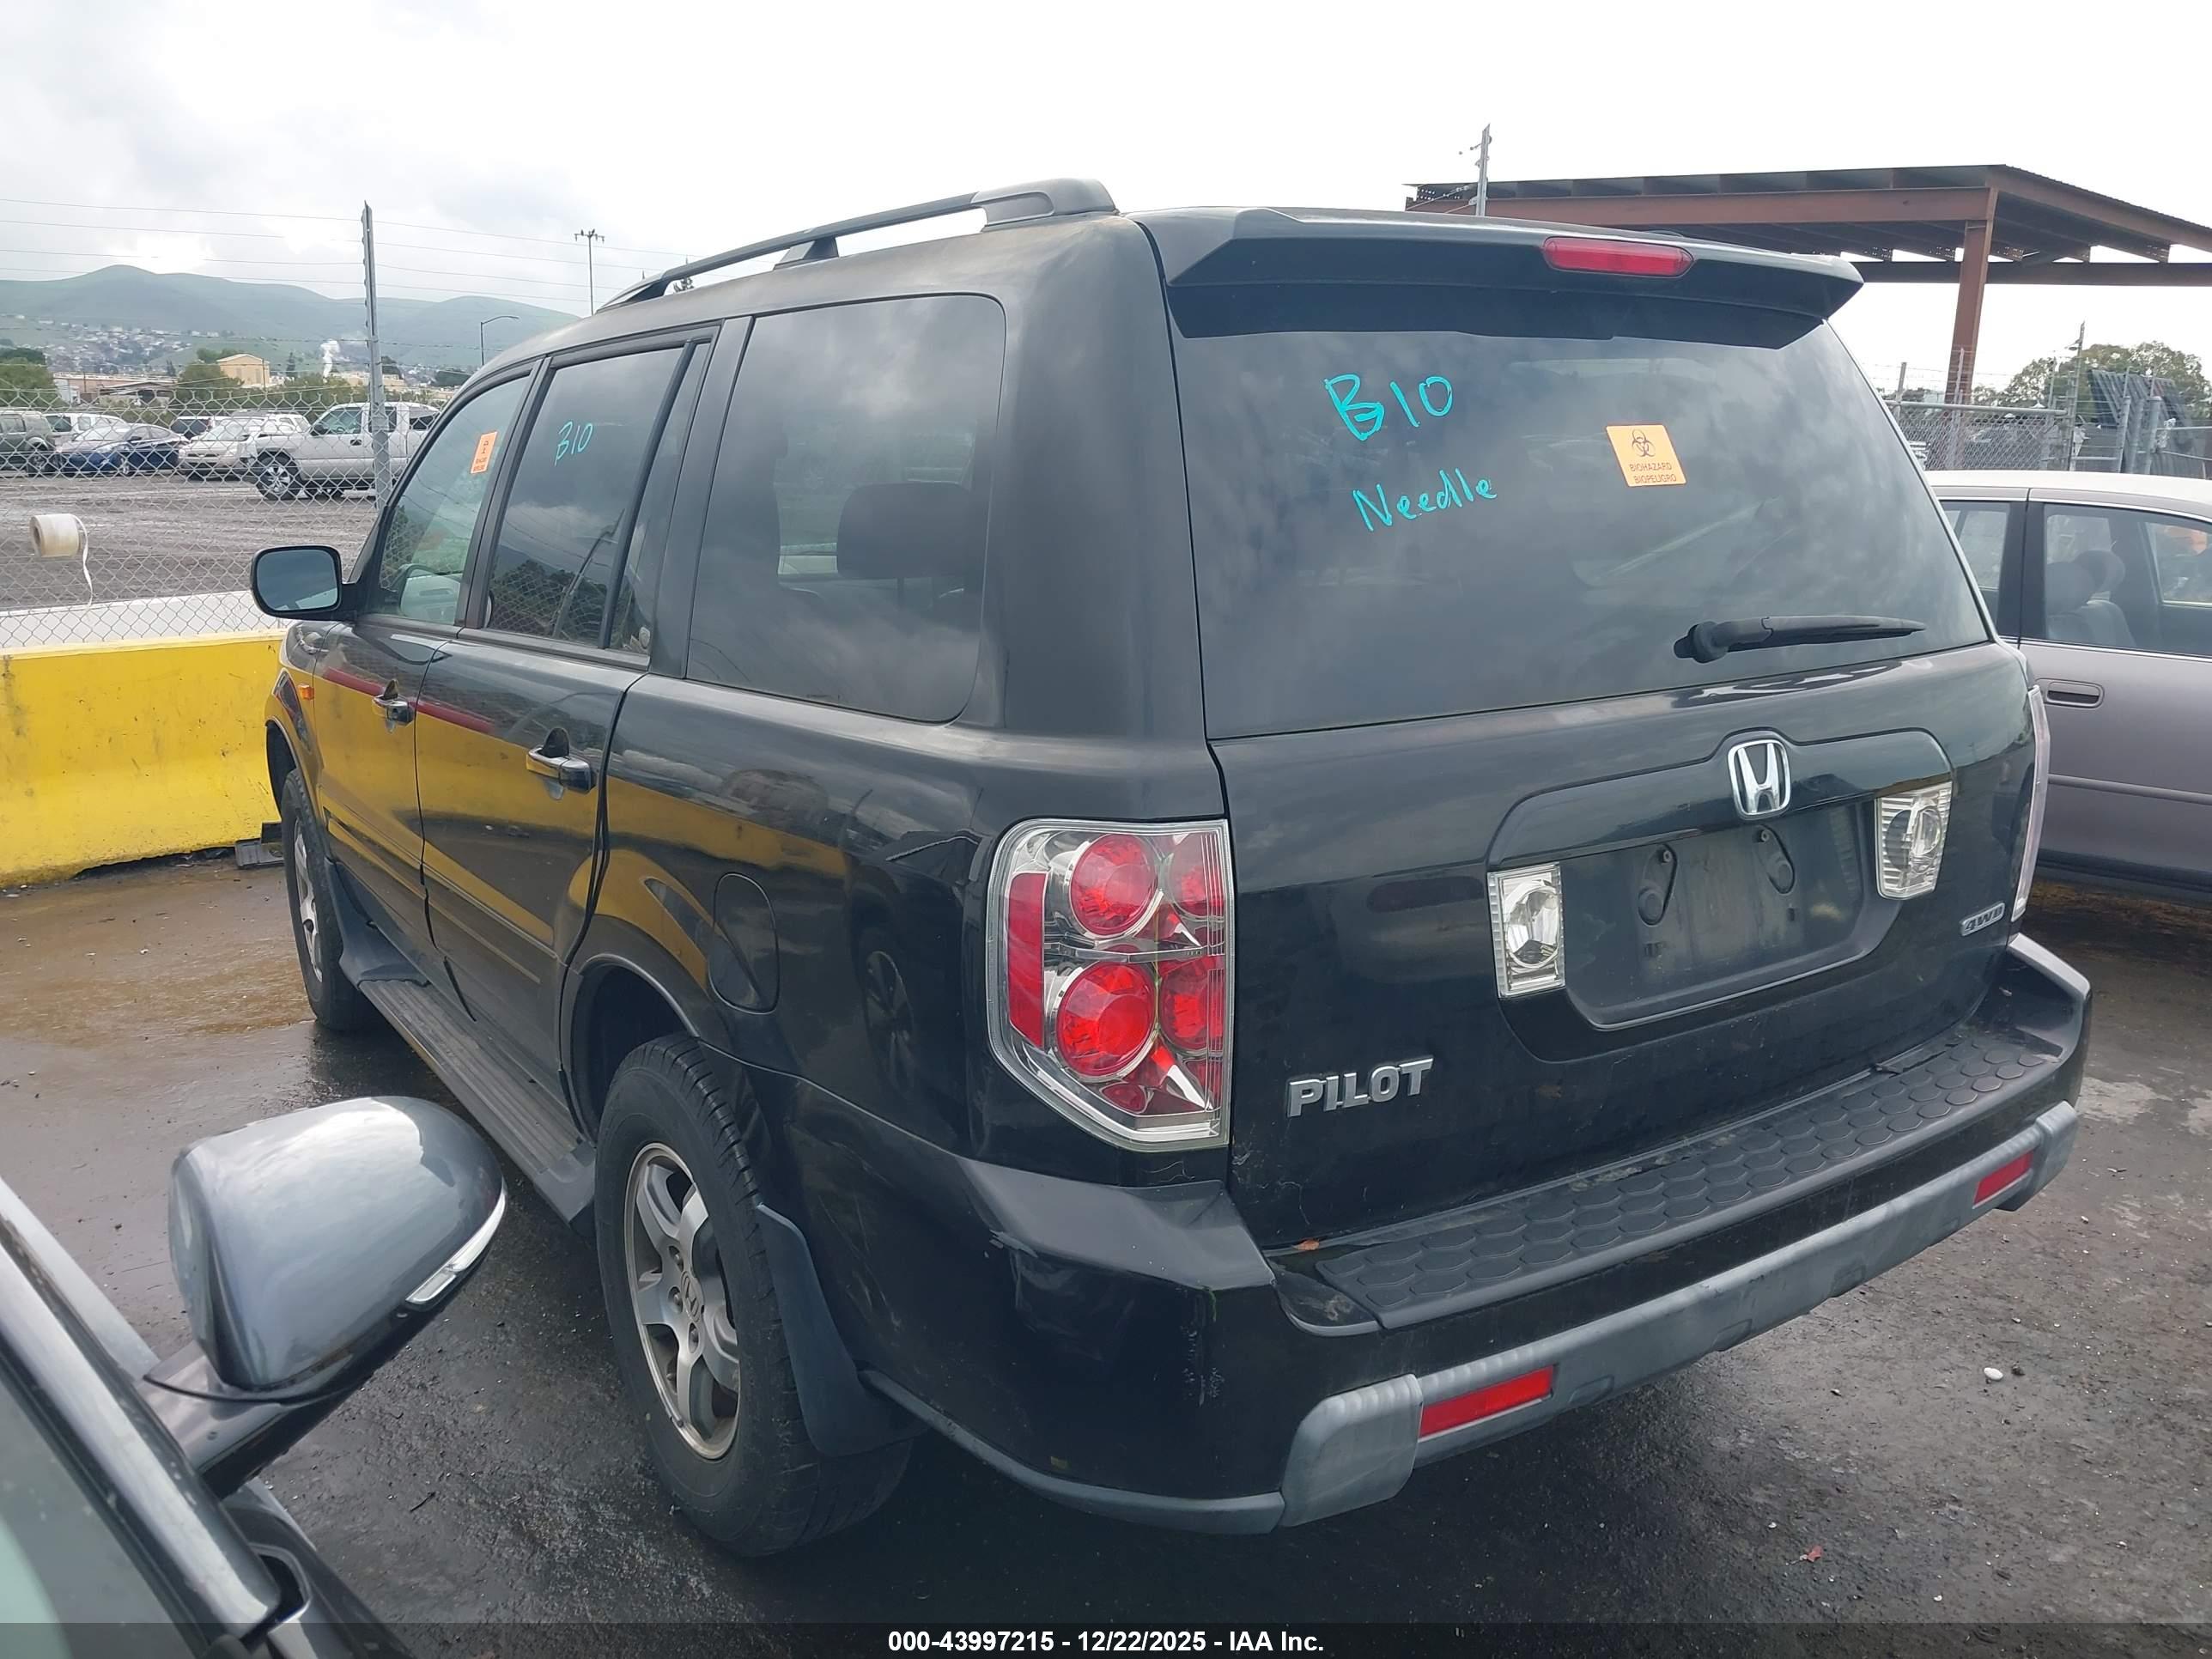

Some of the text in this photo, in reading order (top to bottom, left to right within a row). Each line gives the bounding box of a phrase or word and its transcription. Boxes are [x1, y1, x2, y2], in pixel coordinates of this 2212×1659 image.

[1629, 462, 1673, 472] BIOHAZARD
[1633, 473, 1677, 484] BIOPELIGRO
[1352, 467, 1498, 532] Needle
[1288, 1057, 1433, 1117] PILOT
